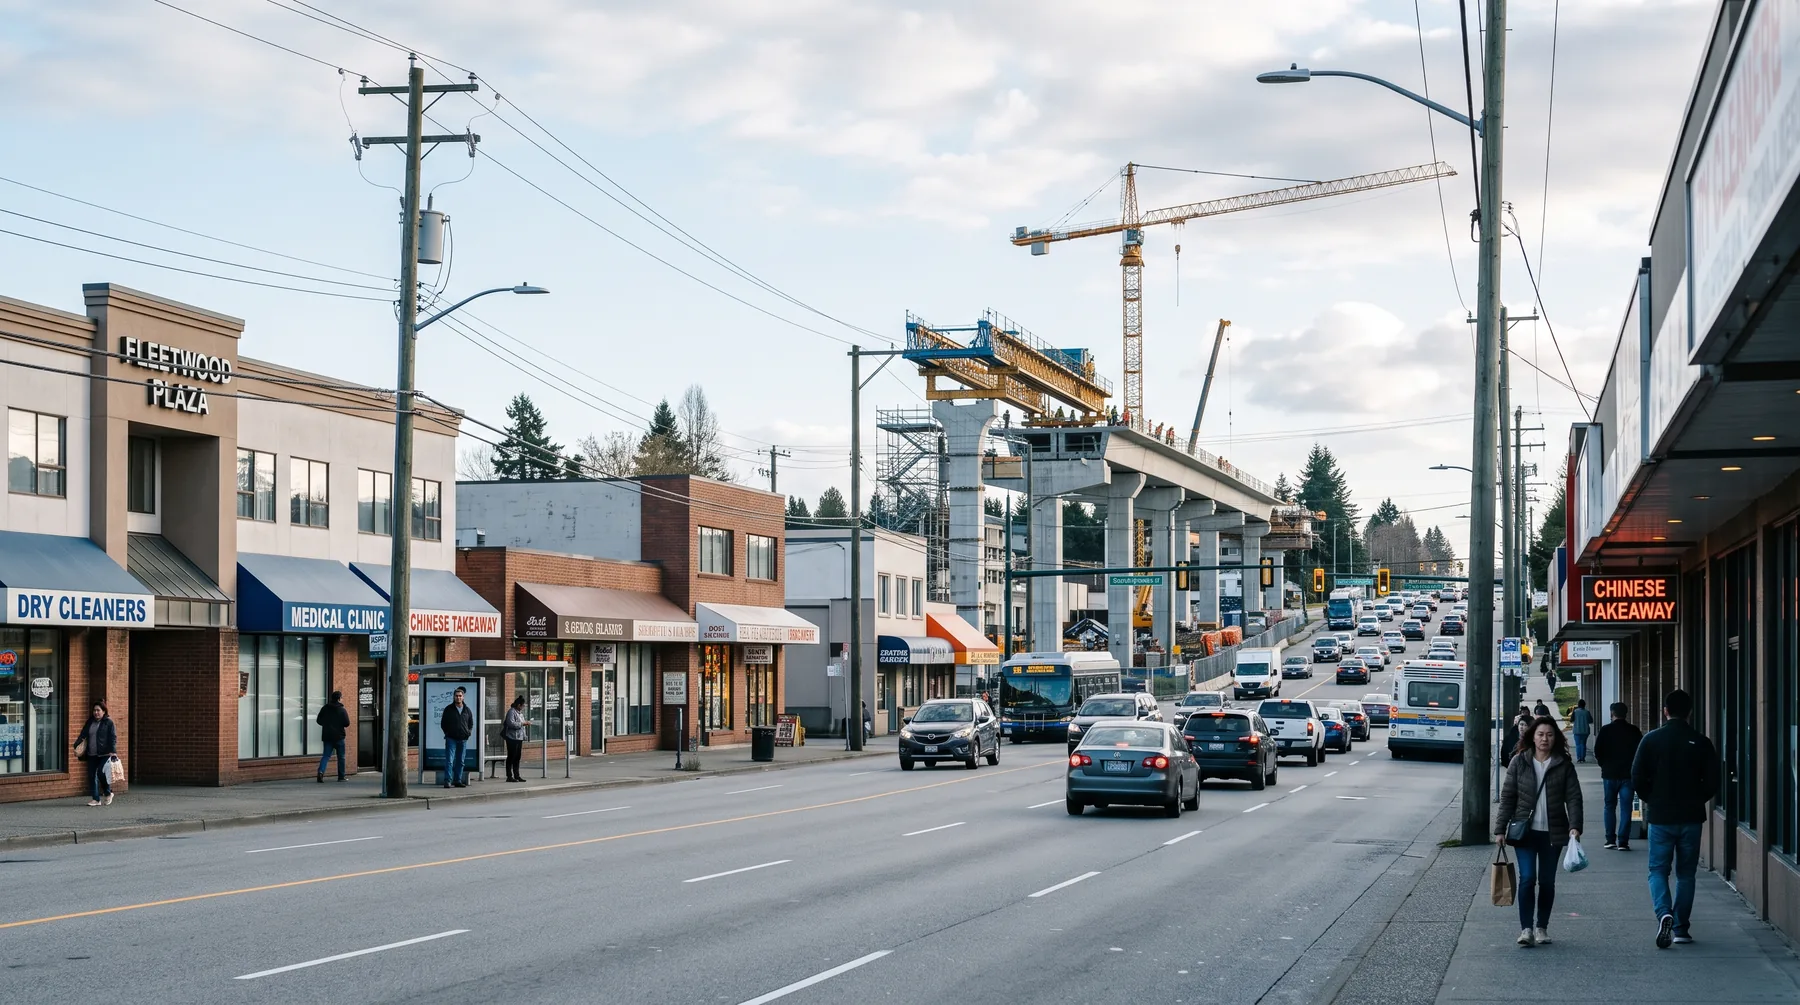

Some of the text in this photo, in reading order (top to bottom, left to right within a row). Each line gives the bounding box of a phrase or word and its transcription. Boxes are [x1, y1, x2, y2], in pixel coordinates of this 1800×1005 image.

[123, 336, 232, 384] FLEETWOOD
[151, 378, 210, 415] PLAZA
[1594, 579, 1666, 598] CHINESE
[17, 593, 147, 622] DRY CLEANERS
[291, 606, 385, 630] MEDICAL CLINIC
[1585, 601, 1676, 620] TAKEAWAY
[410, 613, 498, 633] CHINESE TAKEAWAY
